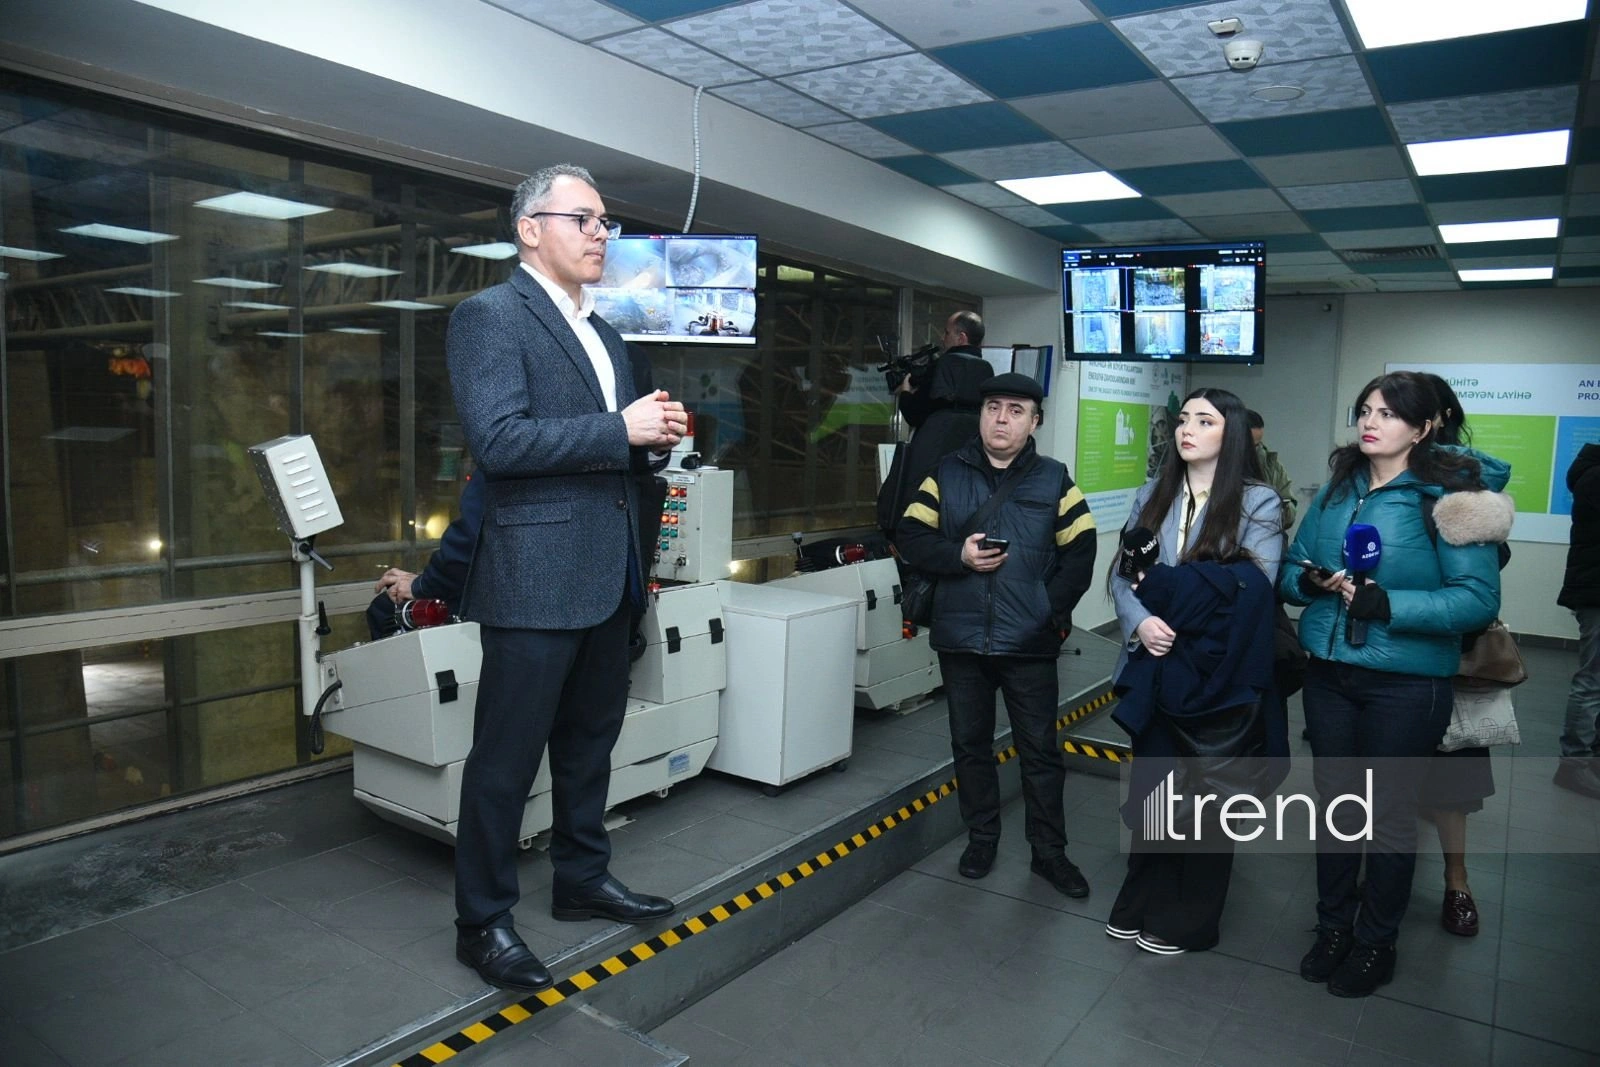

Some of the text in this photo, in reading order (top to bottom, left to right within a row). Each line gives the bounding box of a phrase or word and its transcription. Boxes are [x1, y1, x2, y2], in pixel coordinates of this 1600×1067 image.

[1578, 380, 1594, 388] AN
[1455, 390, 1532, 400] MƏYƏN LAYİHƏ
[1578, 392, 1600, 401] PRO
